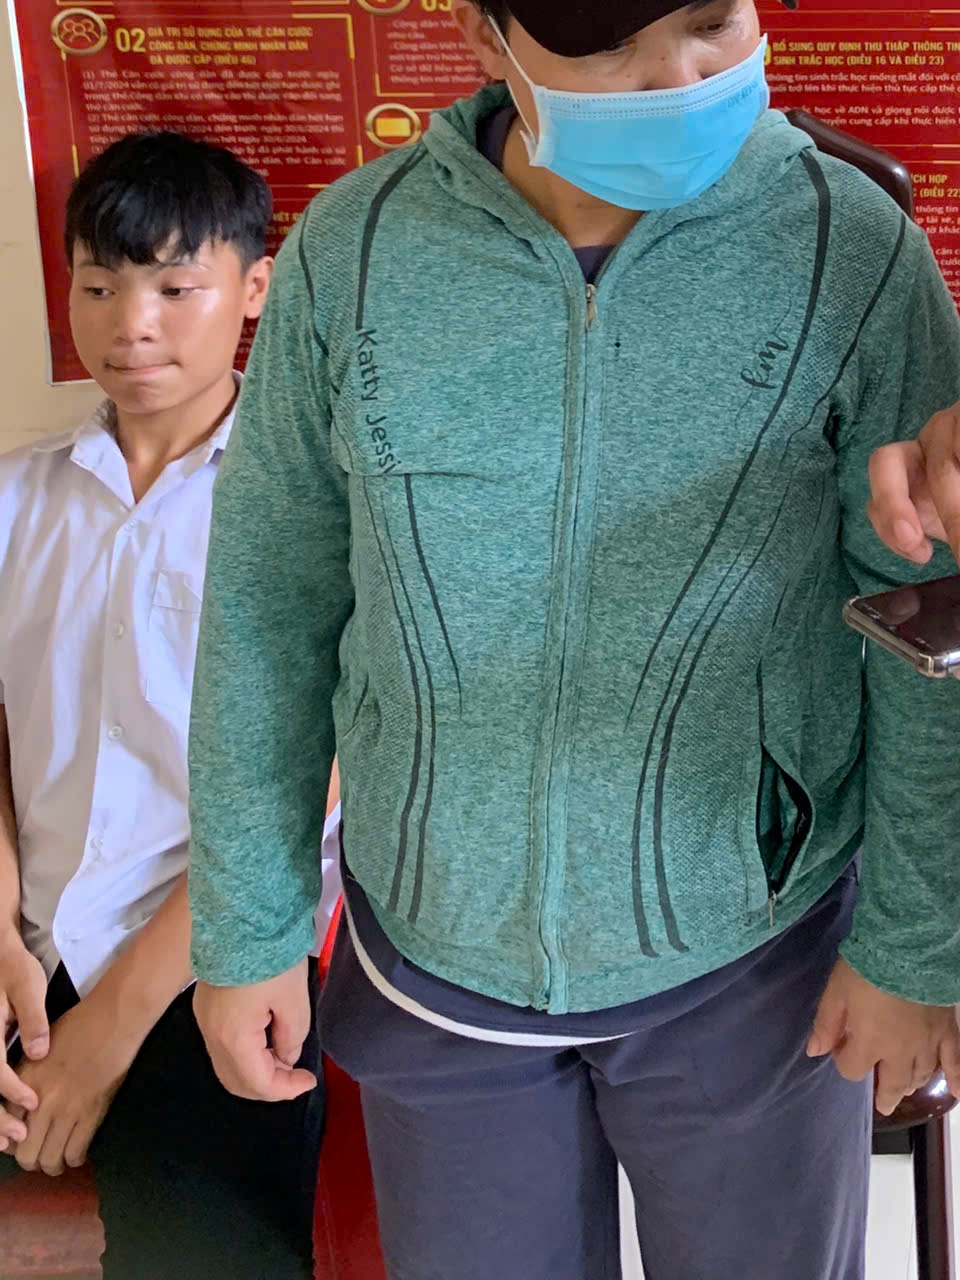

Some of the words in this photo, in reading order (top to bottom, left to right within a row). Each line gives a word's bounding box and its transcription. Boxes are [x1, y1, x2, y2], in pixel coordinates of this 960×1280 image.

[115, 27, 146, 53] 02
[789, 42, 814, 52] SUNG
[817, 42, 835, 52] QUY
[839, 42, 861, 53] ĐỊNH
[864, 42, 882, 51] THU
[913, 40, 943, 51] THÔNG
[946, 42, 960, 51] TIN
[773, 55, 795, 65] SINH
[799, 54, 822, 65] TRẮC
[825, 55, 844, 66] HỌC
[847, 53, 872, 65] (ĐIỀU
[875, 55, 886, 65] 16
[889, 54, 902, 65] VÀ
[905, 54, 926, 65] ĐIỀU
[929, 55, 944, 65] 23)
[848, 106, 868, 114] ADN
[929, 174, 948, 184] HỢP
[920, 187, 944, 198] (ĐIỀU
[916, 205, 944, 214] thông
[357, 329, 381, 402] Katty
